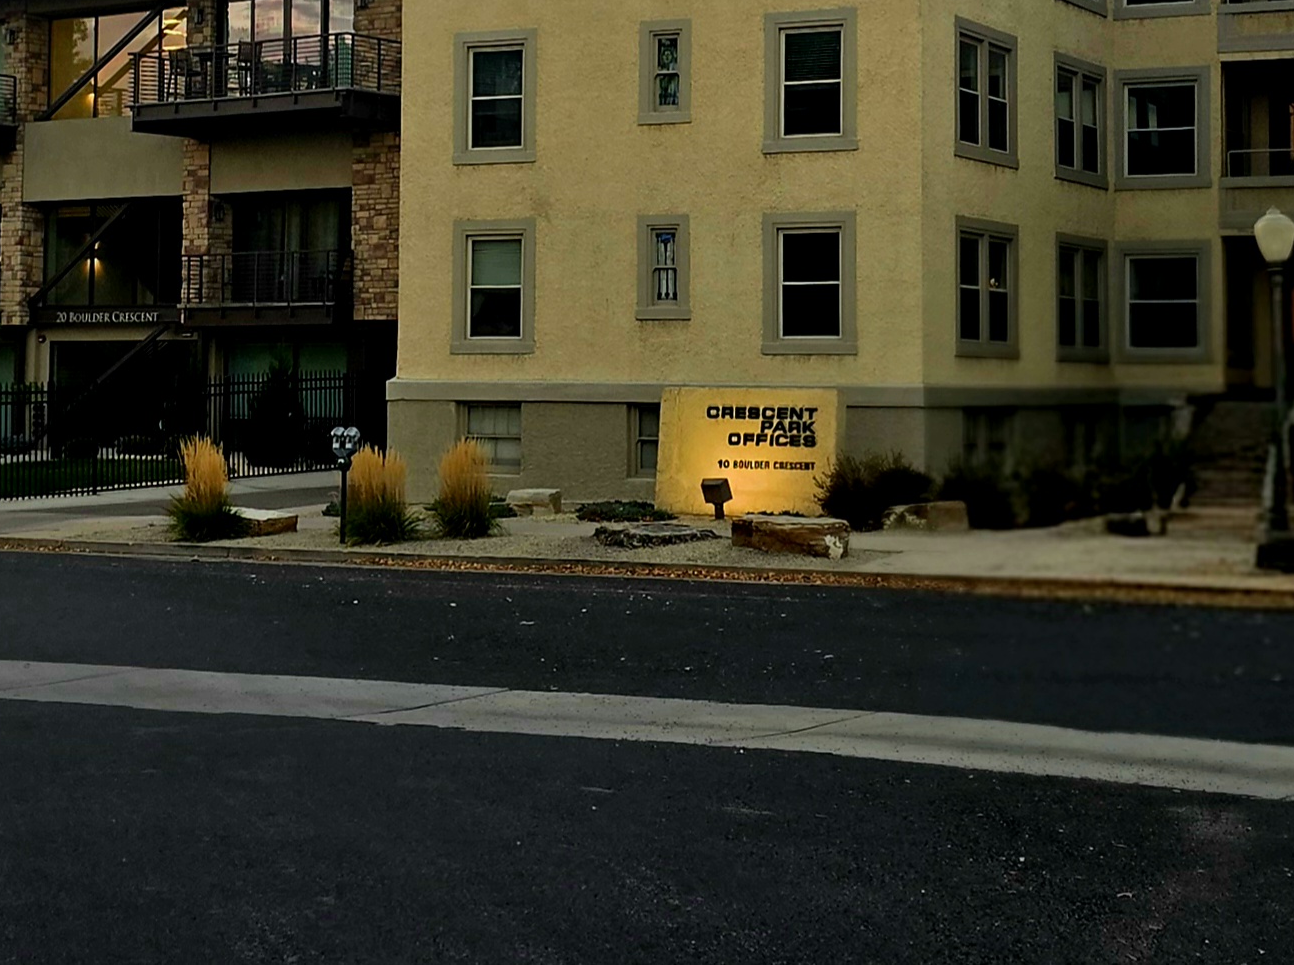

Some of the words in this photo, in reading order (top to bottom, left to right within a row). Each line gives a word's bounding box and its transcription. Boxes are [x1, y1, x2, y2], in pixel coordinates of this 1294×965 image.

[56, 311, 67, 323] 20
[69, 311, 111, 323] BOULDER
[111, 310, 159, 323] CRESCENT
[706, 406, 818, 420] CRESCENT
[760, 420, 817, 434] PARK
[728, 433, 818, 447] OFFICES
[733, 460, 770, 470] BOULDER
[774, 461, 816, 471] CRESCENT
